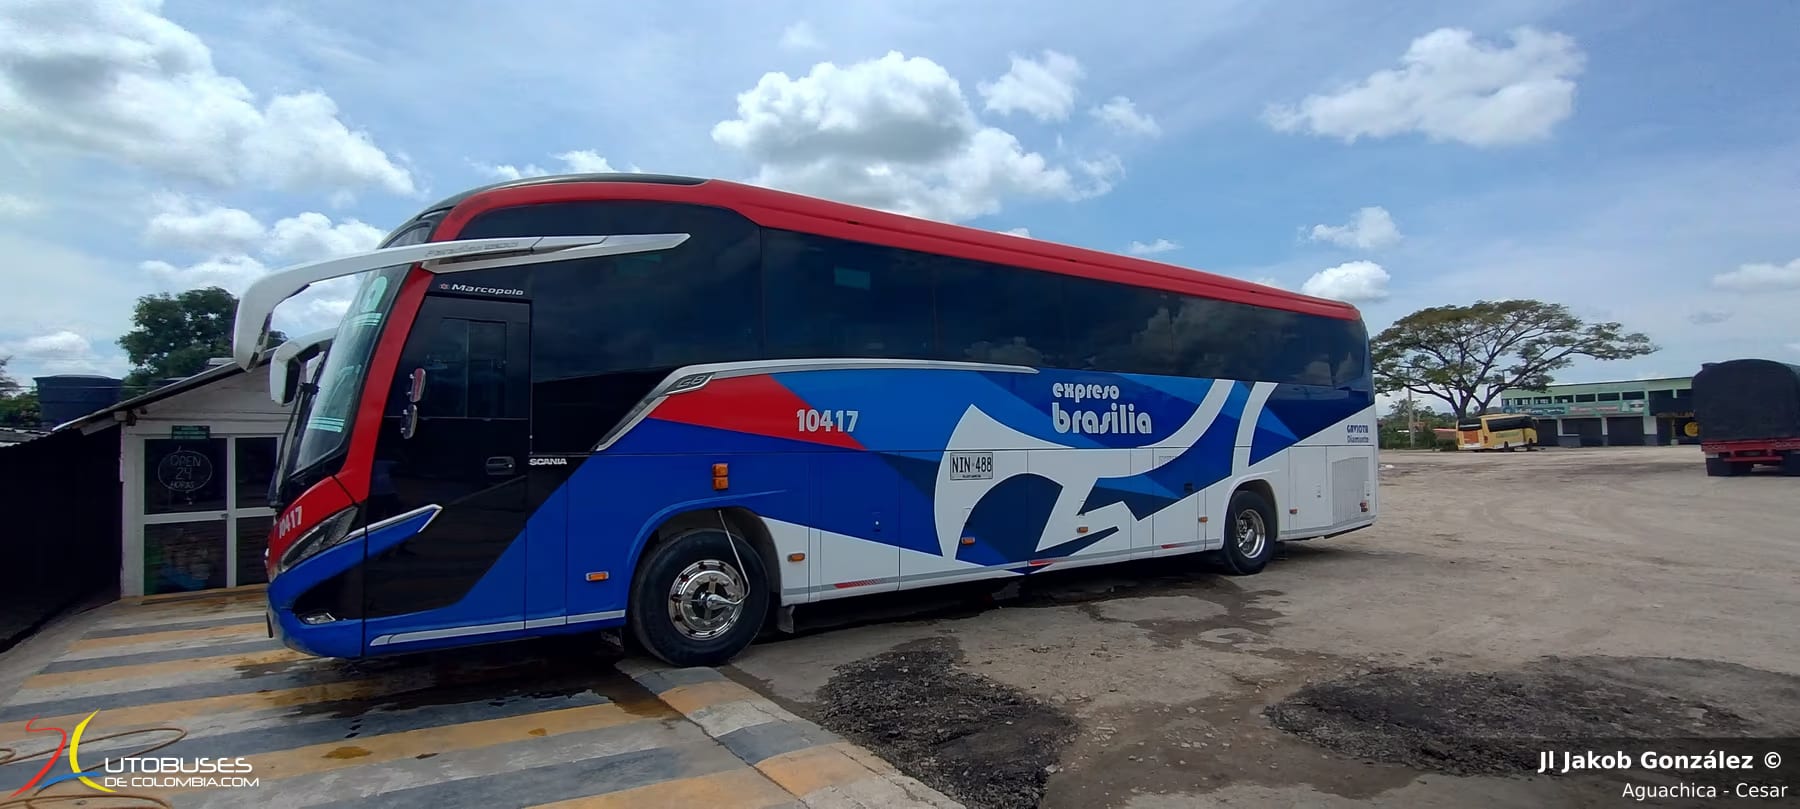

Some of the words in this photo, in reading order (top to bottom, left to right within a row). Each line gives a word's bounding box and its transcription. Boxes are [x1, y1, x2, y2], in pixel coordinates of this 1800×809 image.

[451, 283, 524, 296] Marcopolo
[1052, 382, 1120, 403] expreso
[796, 408, 859, 433] 10417
[1051, 402, 1152, 435] brasilia
[170, 454, 201, 467] OPEN
[529, 458, 568, 466] SCANIA
[952, 456, 971, 473] NIN
[975, 456, 992, 473] 488
[175, 466, 193, 480] 24
[279, 505, 303, 539] 10417
